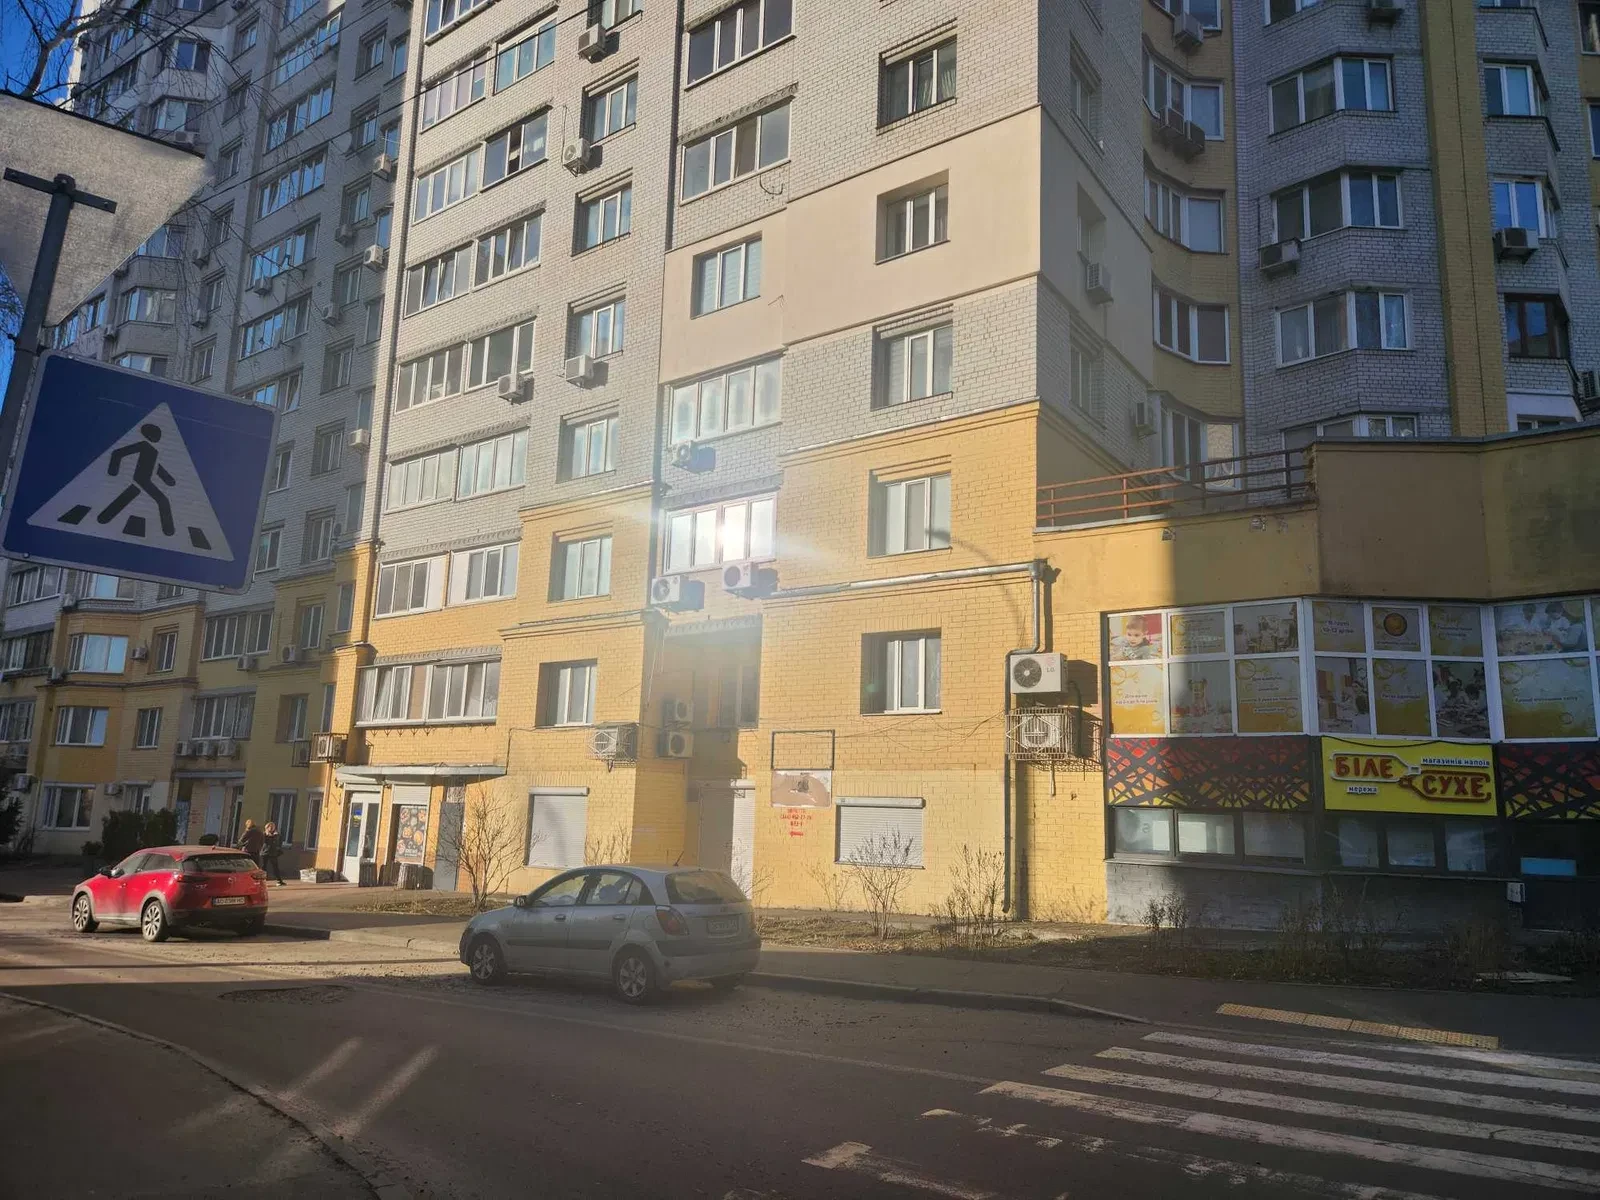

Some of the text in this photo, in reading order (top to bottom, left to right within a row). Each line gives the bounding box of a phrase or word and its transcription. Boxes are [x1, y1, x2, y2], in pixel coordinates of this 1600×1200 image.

[1335, 756, 1394, 779] БІЛЕ
[1348, 785, 1377, 794] мережа
[1422, 775, 1485, 797] СУХЕ
